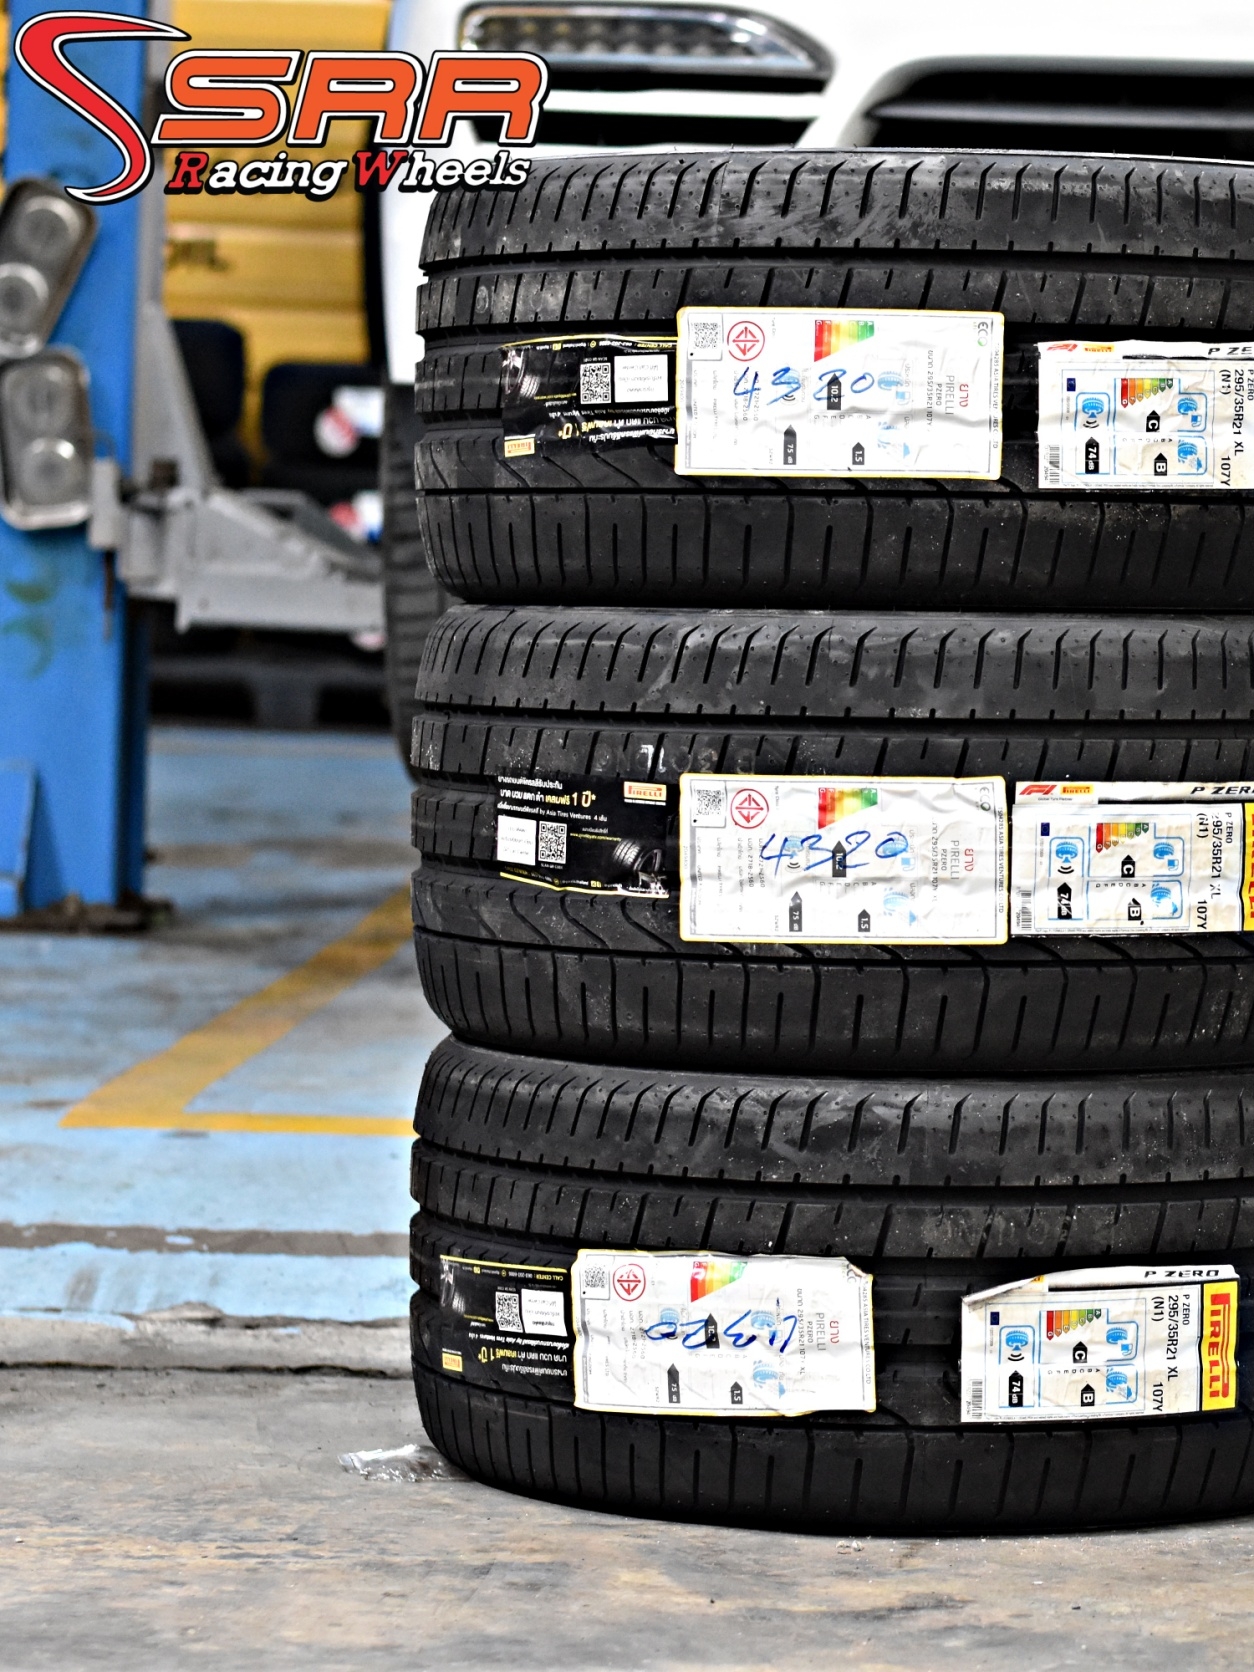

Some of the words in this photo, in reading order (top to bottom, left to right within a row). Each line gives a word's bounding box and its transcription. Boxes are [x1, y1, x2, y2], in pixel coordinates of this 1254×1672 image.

[945, 376, 955, 415] PIRELLI
[959, 384, 968, 407] ยาง
[1232, 369, 1244, 435] 295/35R21
[1148, 420, 1158, 429] C
[1088, 446, 1097, 458] 74
[1234, 441, 1244, 456] XL
[1156, 462, 1165, 472] B
[1220, 456, 1230, 486] 107Y
[628, 785, 662, 797] PIRELLI
[1190, 786, 1205, 795] P
[1196, 813, 1209, 838] (N1)
[1225, 821, 1233, 844] ZERO
[760, 830, 909, 878] 4320
[950, 840, 960, 880] PIRELLI
[964, 848, 974, 872] ยาง
[1123, 864, 1134, 875] C
[1210, 884, 1221, 900] XL
[792, 911, 799, 920] 75
[1130, 908, 1140, 917] B
[1196, 899, 1207, 930] 107Y
[1165, 1270, 1219, 1278] ZERO
[1151, 1296, 1164, 1322] (N1)
[1182, 1302, 1190, 1325] ZERO
[797, 1309, 805, 1346] 295/35R21
[816, 1312, 826, 1351] PIRELLI
[830, 1320, 840, 1344] ยาง
[1166, 1295, 1179, 1360] 295/35R21
[1075, 1350, 1085, 1360] C
[1208, 1293, 1231, 1399] PIRELLI
[1167, 1366, 1178, 1382] XL
[671, 1383, 677, 1392] 75
[733, 1390, 741, 1401] 1.5
[1011, 1380, 1020, 1393] 74
[1011, 1394, 1018, 1404] dB
[1083, 1393, 1094, 1403] B
[1152, 1382, 1163, 1412] 107Y
